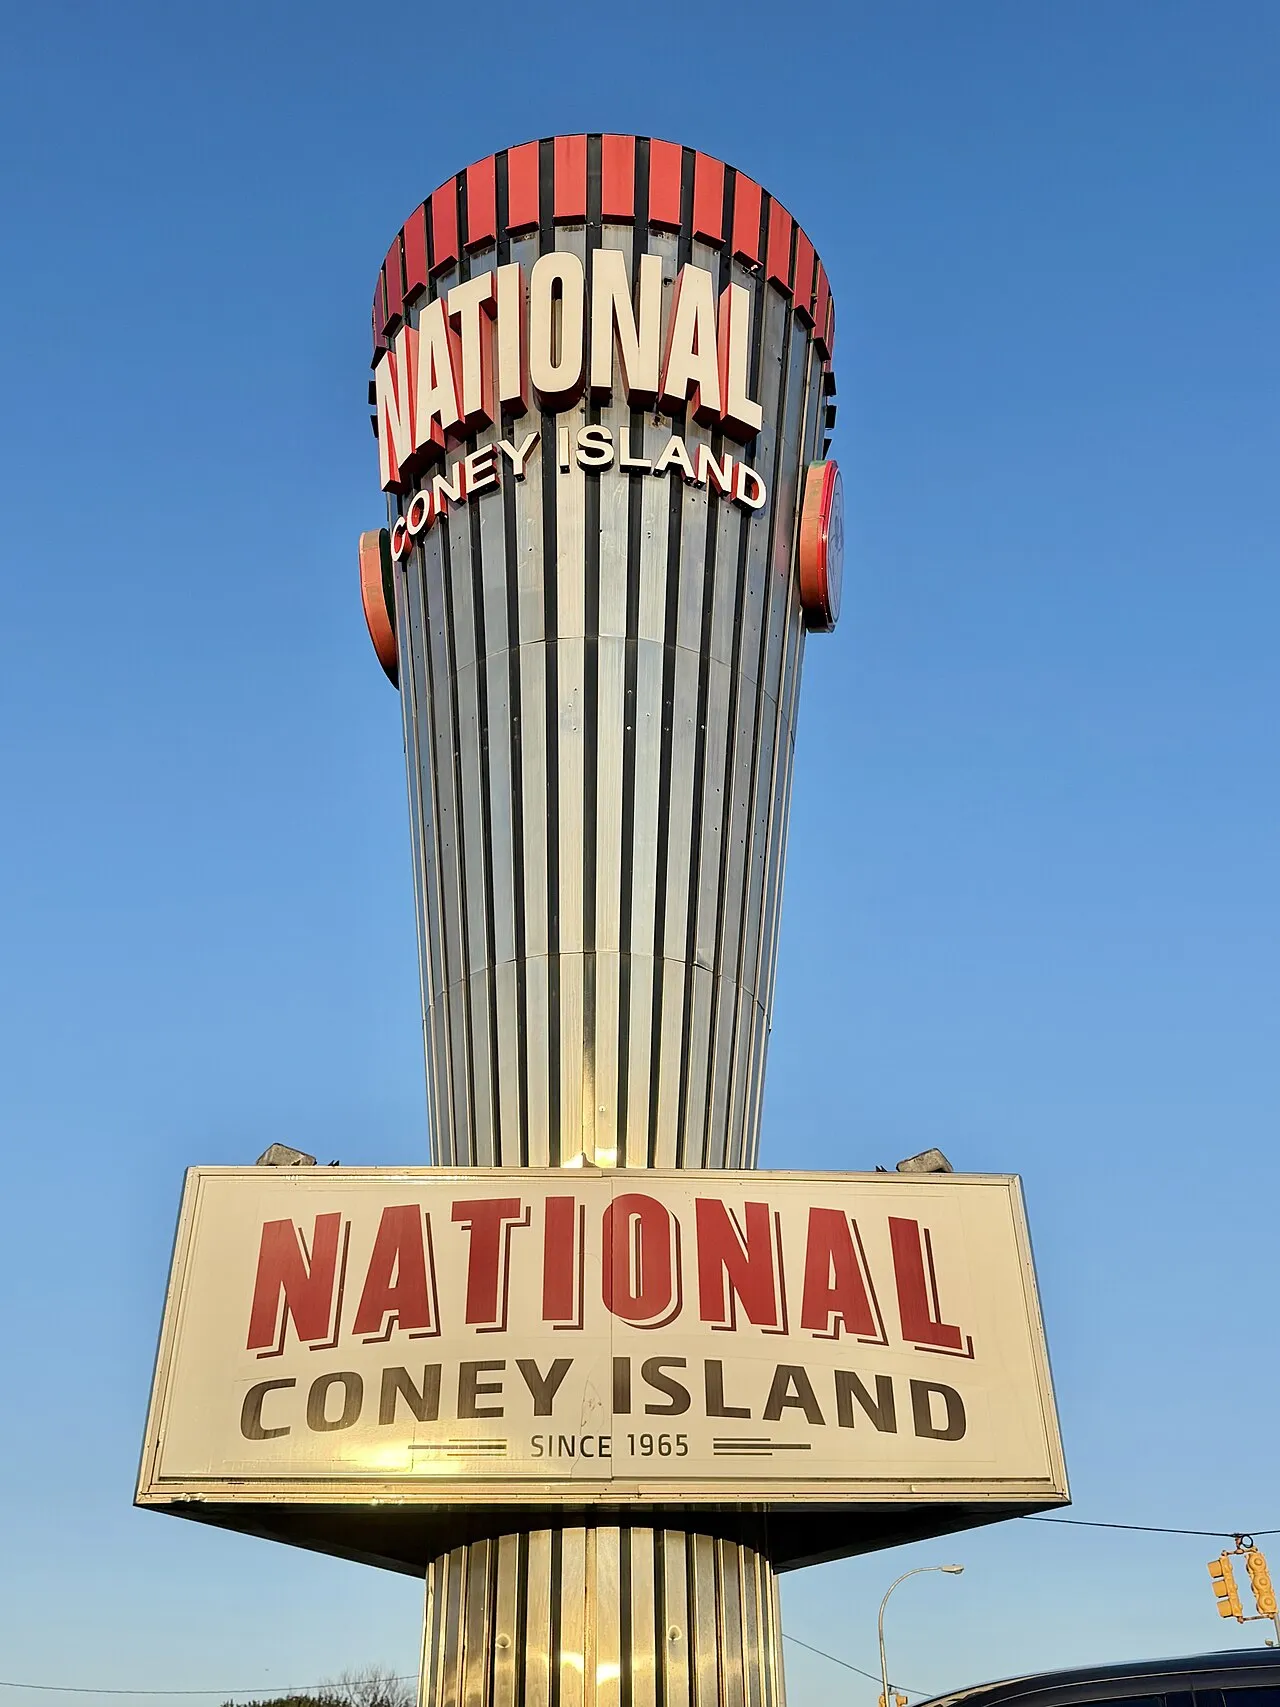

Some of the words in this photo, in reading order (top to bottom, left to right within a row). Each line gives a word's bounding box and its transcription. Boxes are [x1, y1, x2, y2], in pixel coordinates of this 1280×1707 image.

[374, 248, 763, 492] NATIONAL
[391, 432, 540, 561] CONEY
[559, 425, 767, 510] ISLAND
[246, 1193, 974, 1360] NATIONAL
[240, 1358, 574, 1441] CONEY
[612, 1356, 967, 1442] ISLAND
[531, 1435, 612, 1458] SINCE
[627, 1433, 689, 1457] 1965
